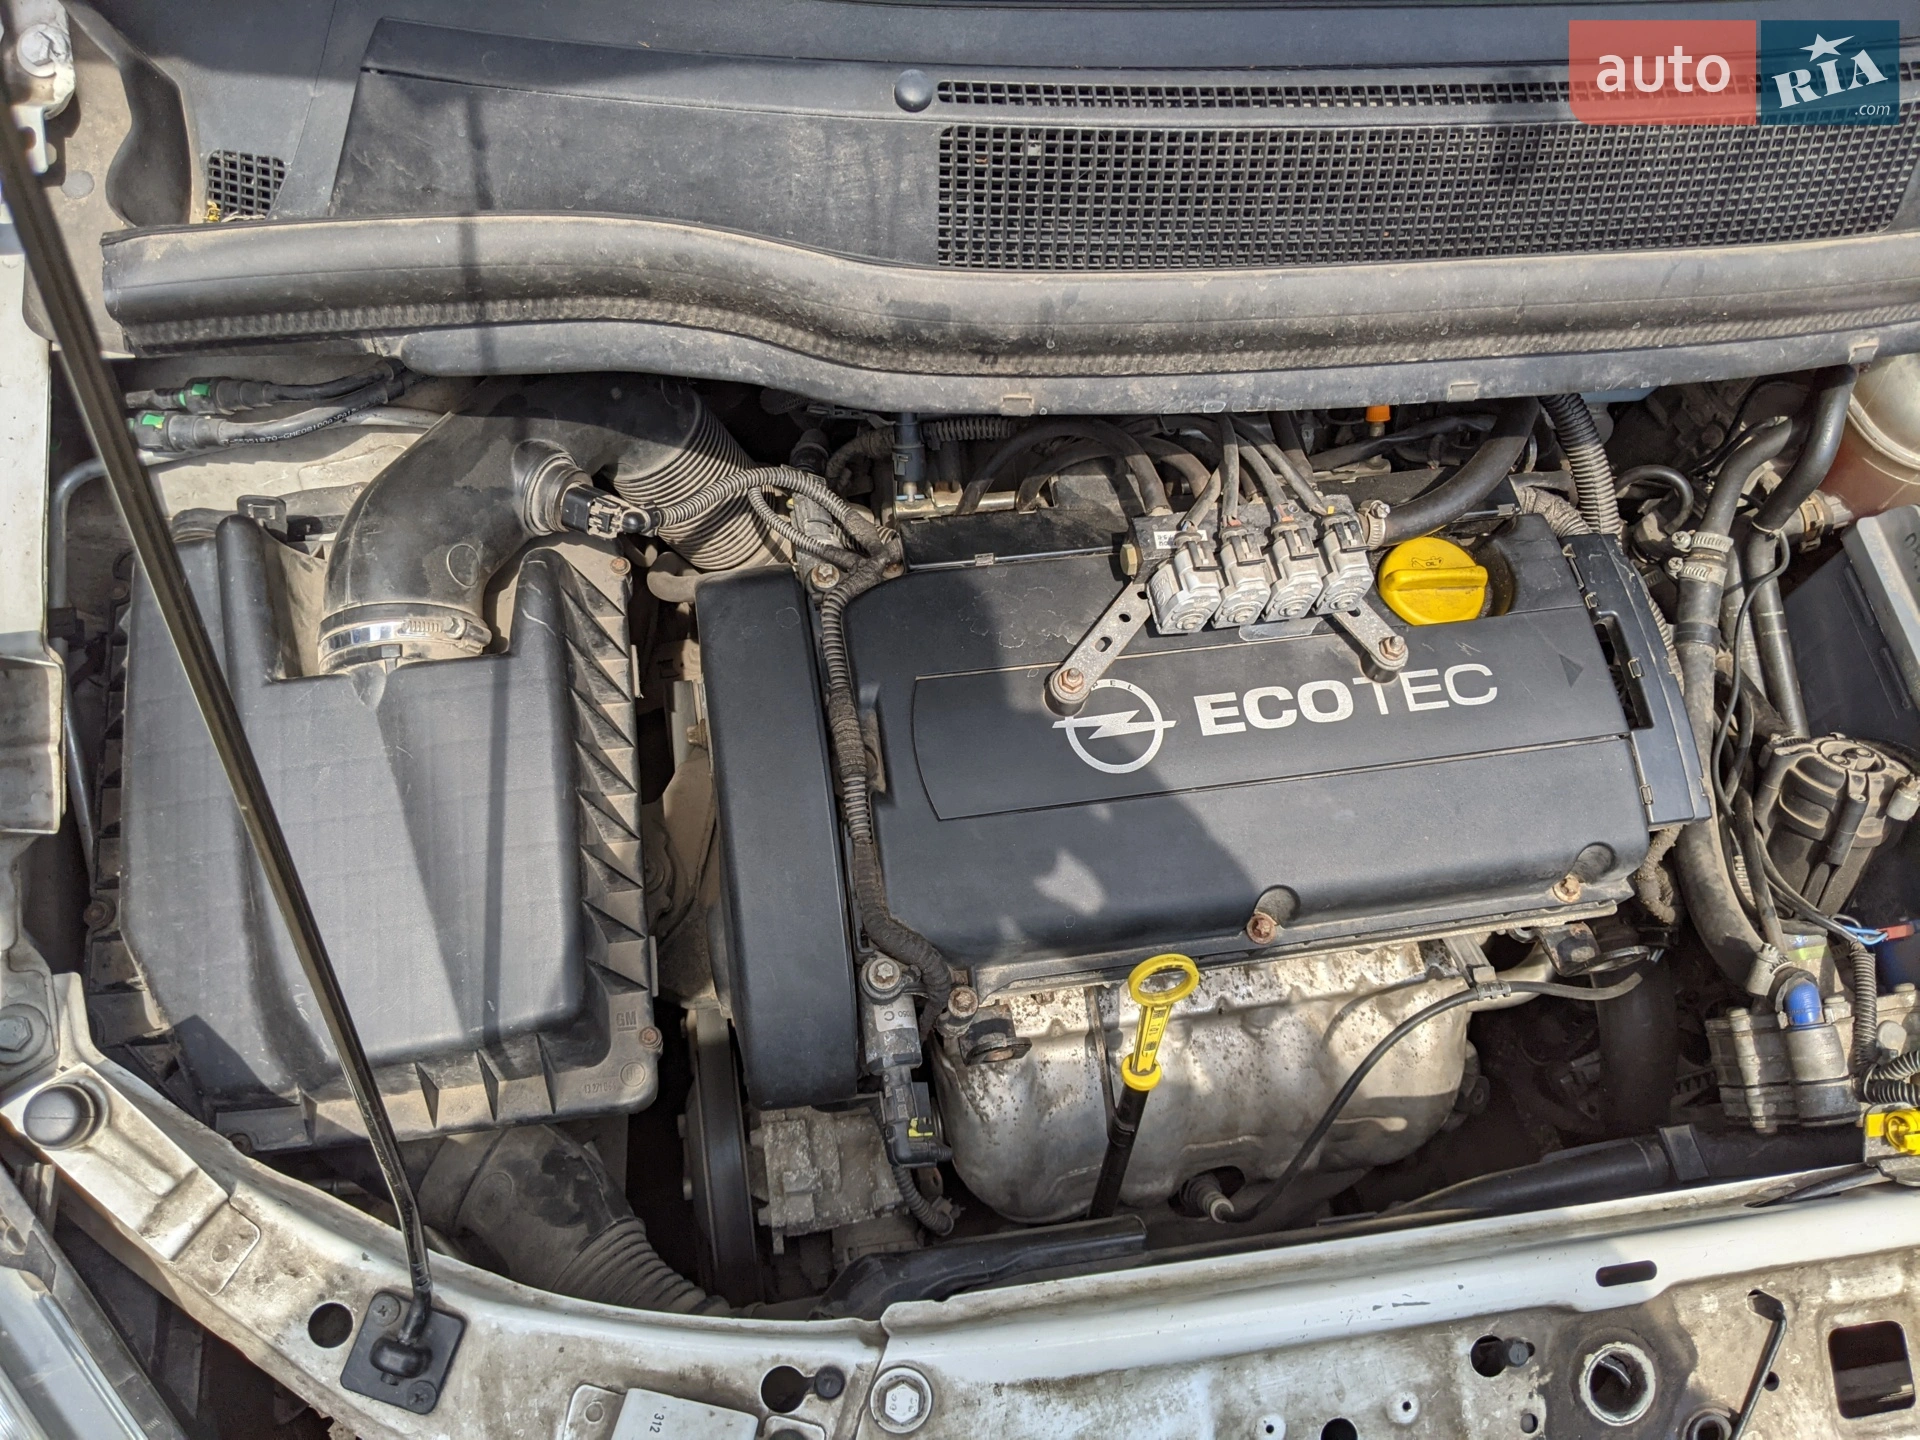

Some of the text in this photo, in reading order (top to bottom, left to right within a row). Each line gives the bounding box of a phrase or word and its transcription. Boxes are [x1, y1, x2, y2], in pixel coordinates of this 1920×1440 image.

[1193, 663, 1498, 736] ECOTEC
[616, 1011, 637, 1027] GM
[649, 1413, 665, 1433] 312
